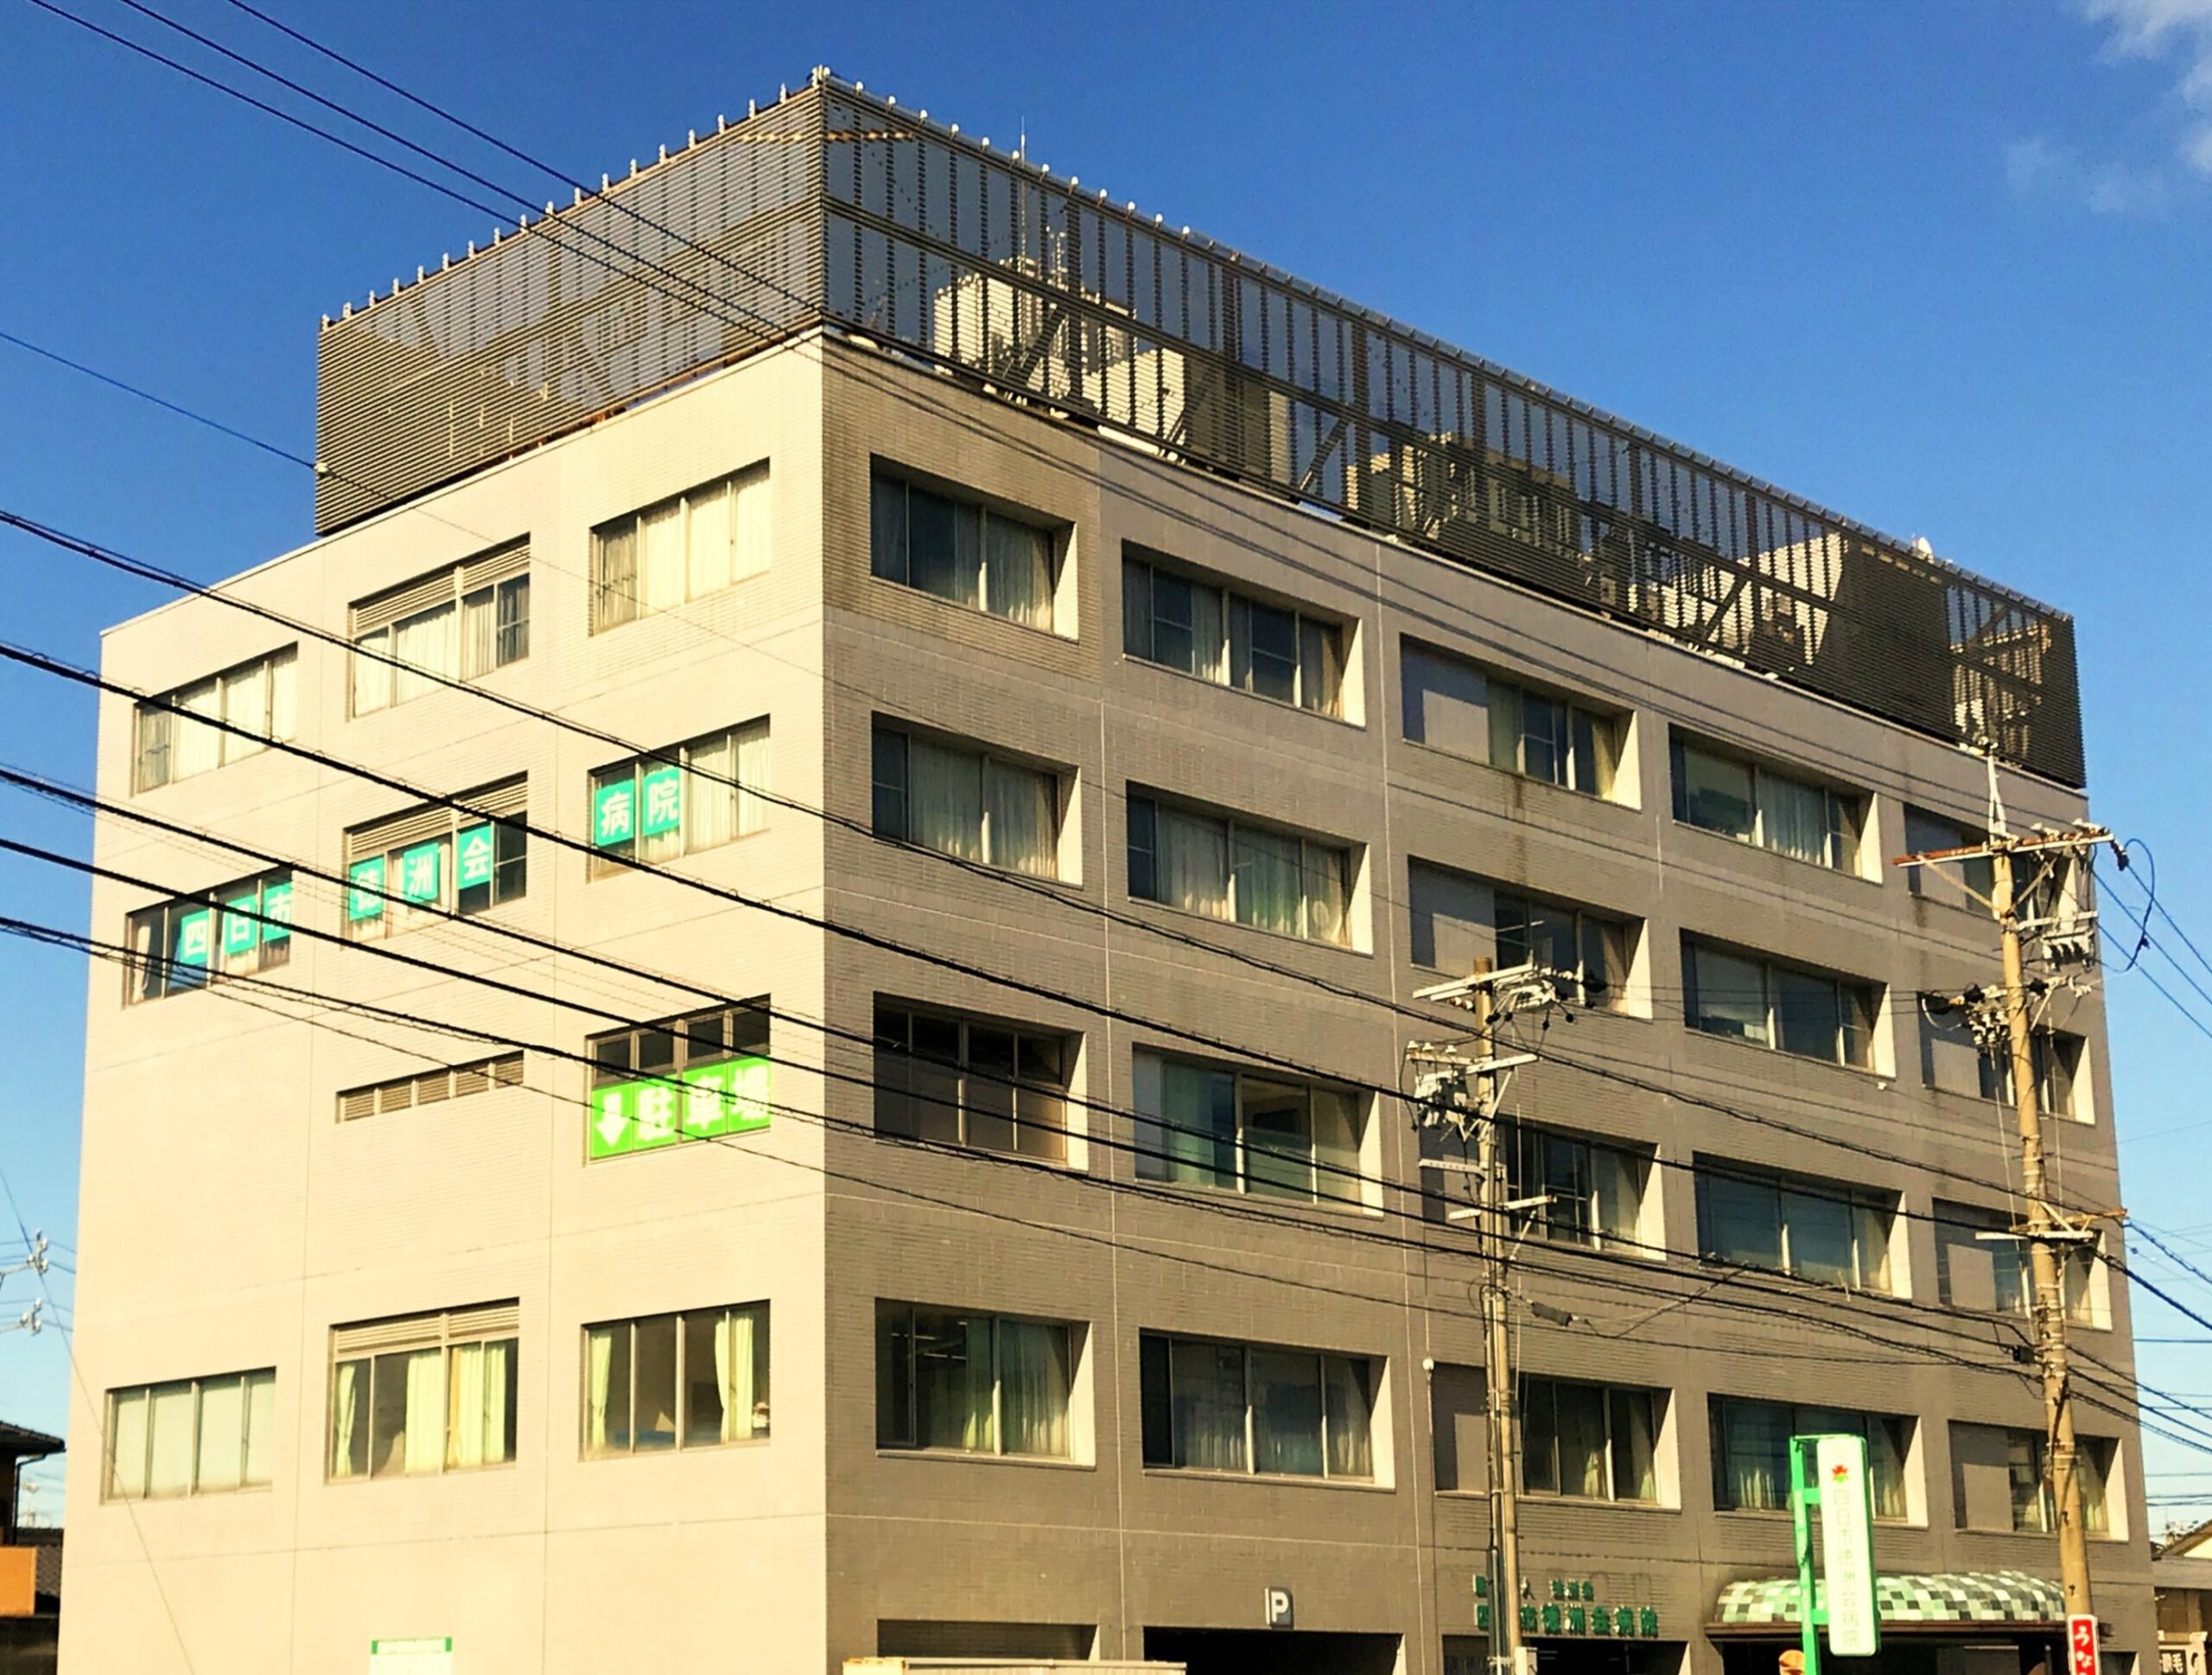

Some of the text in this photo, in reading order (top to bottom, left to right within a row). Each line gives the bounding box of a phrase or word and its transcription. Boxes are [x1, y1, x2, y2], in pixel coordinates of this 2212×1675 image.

[185, 777, 679, 958] 四日市 徳洲会 病院
[638, 1064, 768, 1141] 駐車場
[1270, 1590, 1289, 1622] P
[2074, 1625, 2094, 1675] うな
